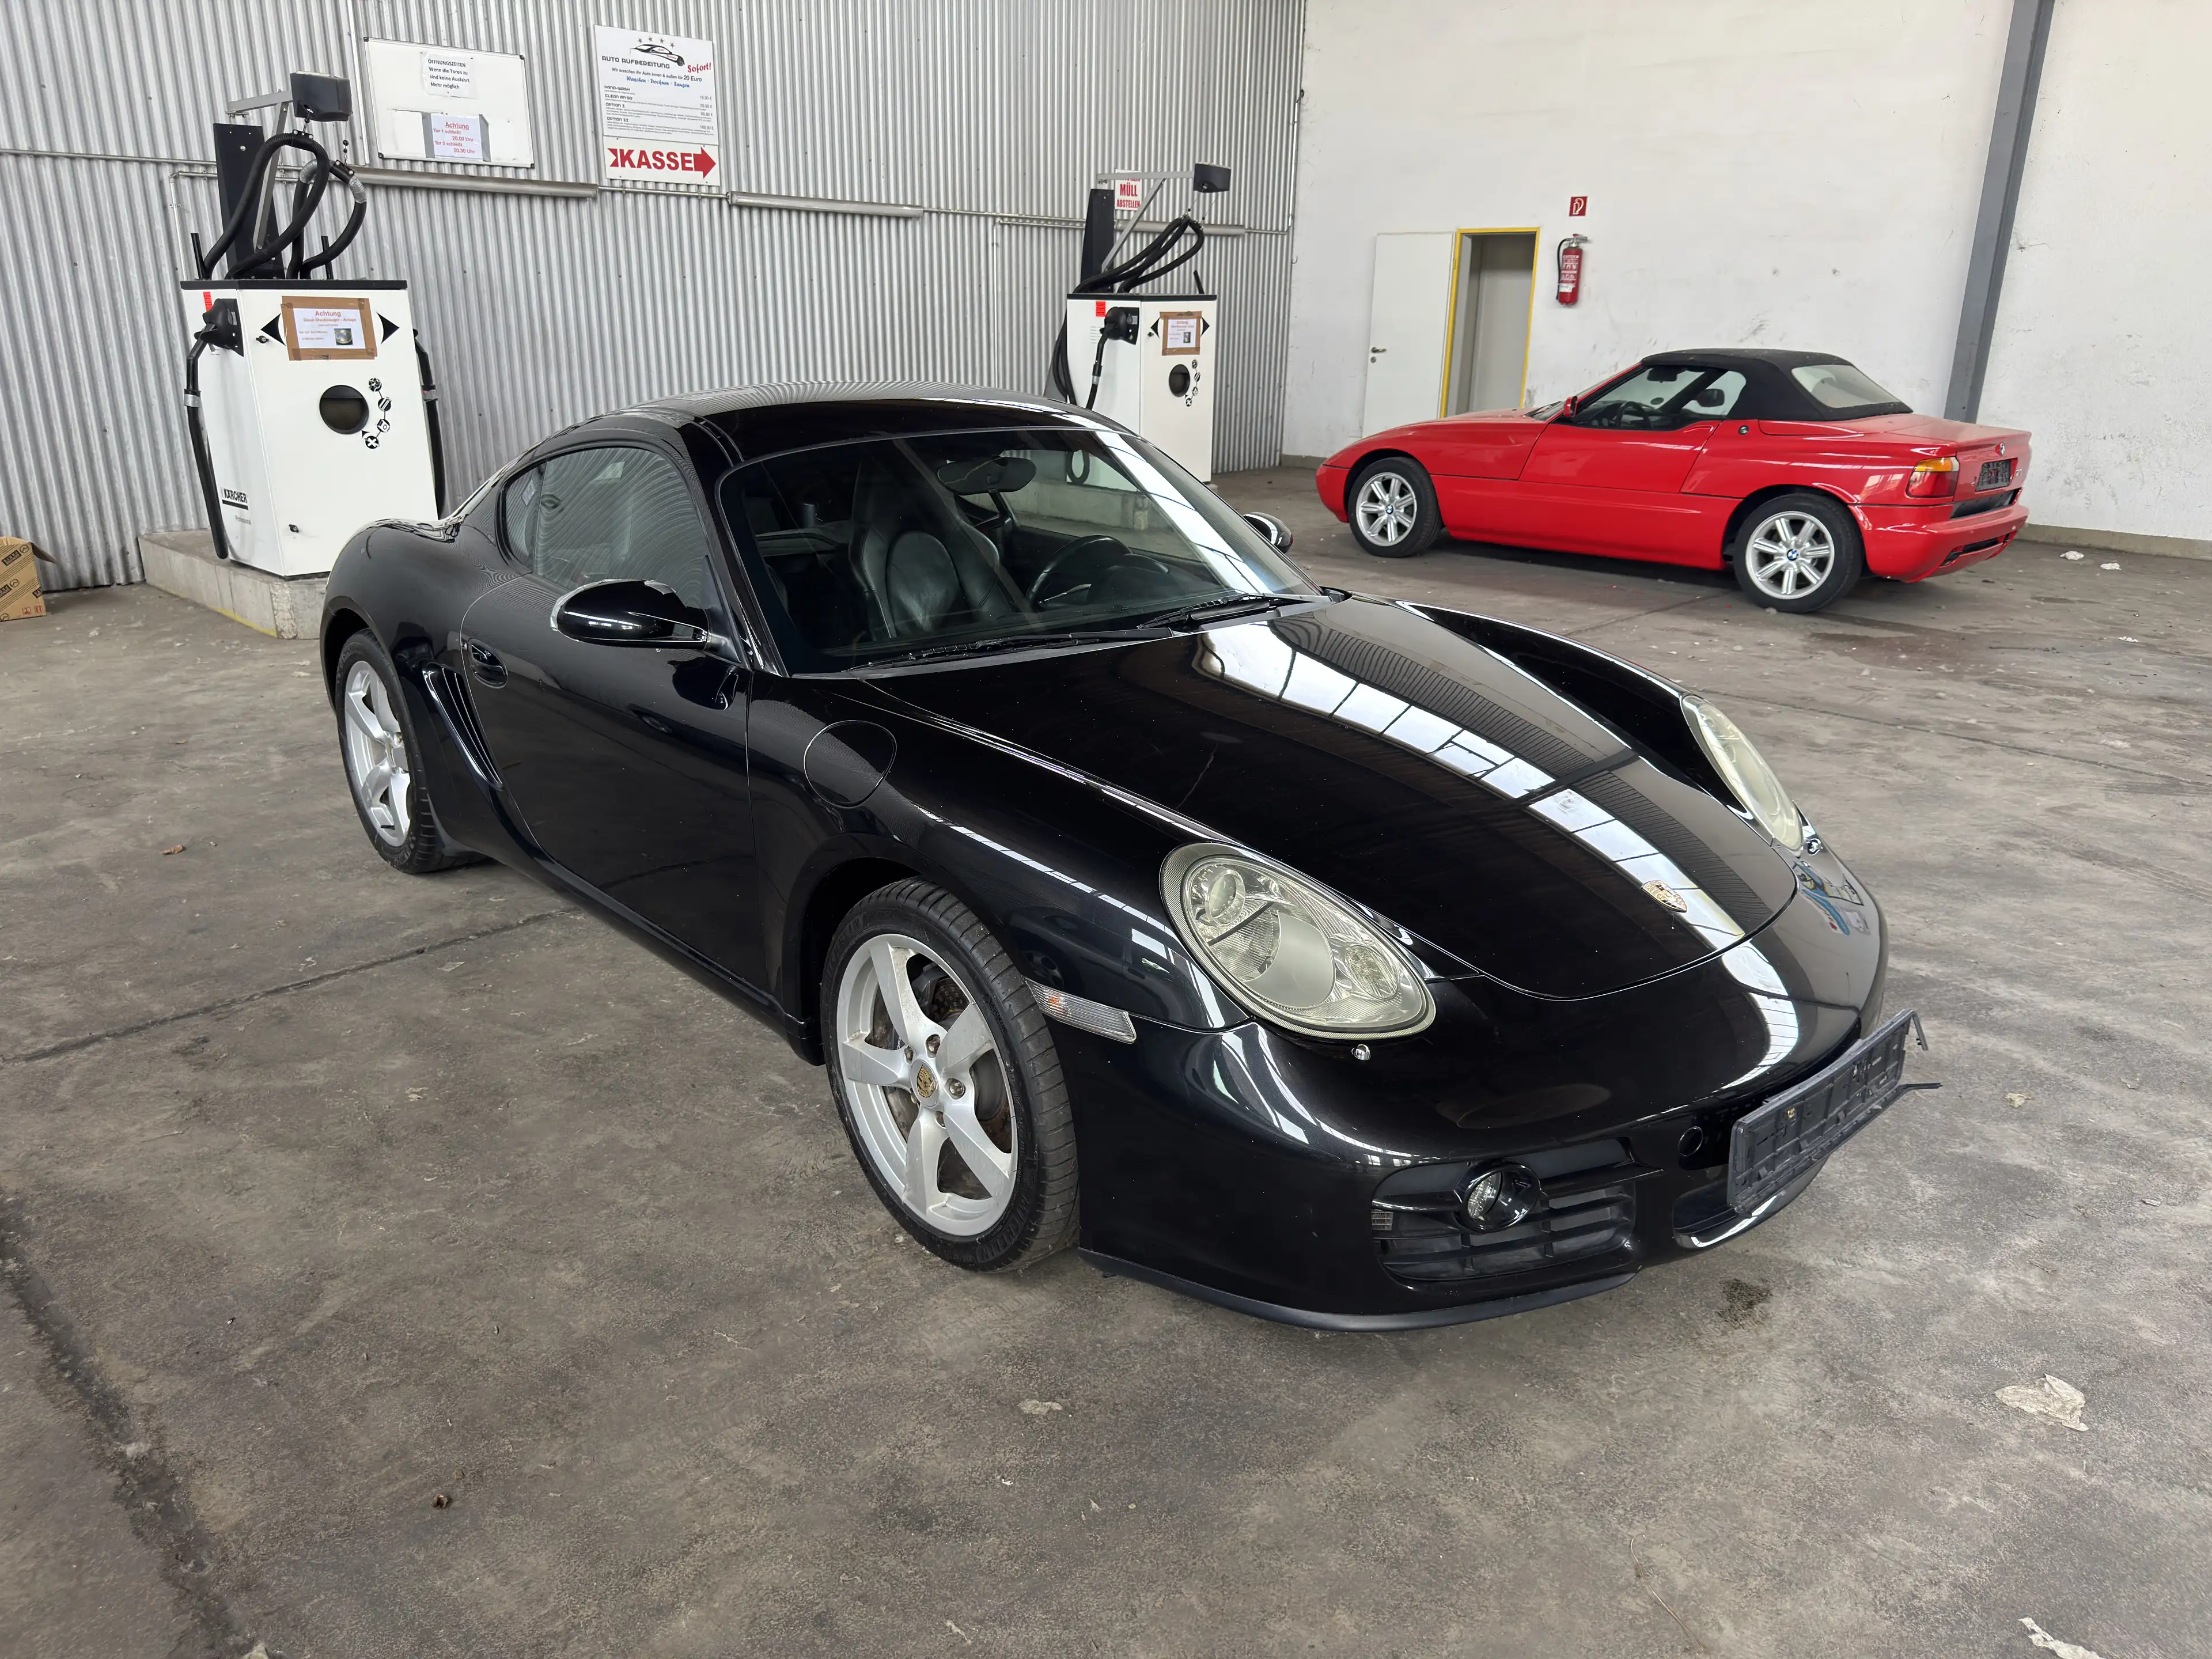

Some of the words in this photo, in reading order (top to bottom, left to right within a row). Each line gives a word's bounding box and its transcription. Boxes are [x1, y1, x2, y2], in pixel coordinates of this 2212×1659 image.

[428, 58, 465, 67] ÖFFNUNGSZEITEN
[622, 58, 670, 69] AUFBEREITUNG
[688, 63, 711, 73] Sofort!
[445, 122, 469, 130] Achtung
[620, 149, 693, 172] KASSE
[1120, 182, 1138, 196] MÜLL
[1117, 199, 1140, 208] ABSTELLEN
[224, 488, 248, 503] KÄRCHER
